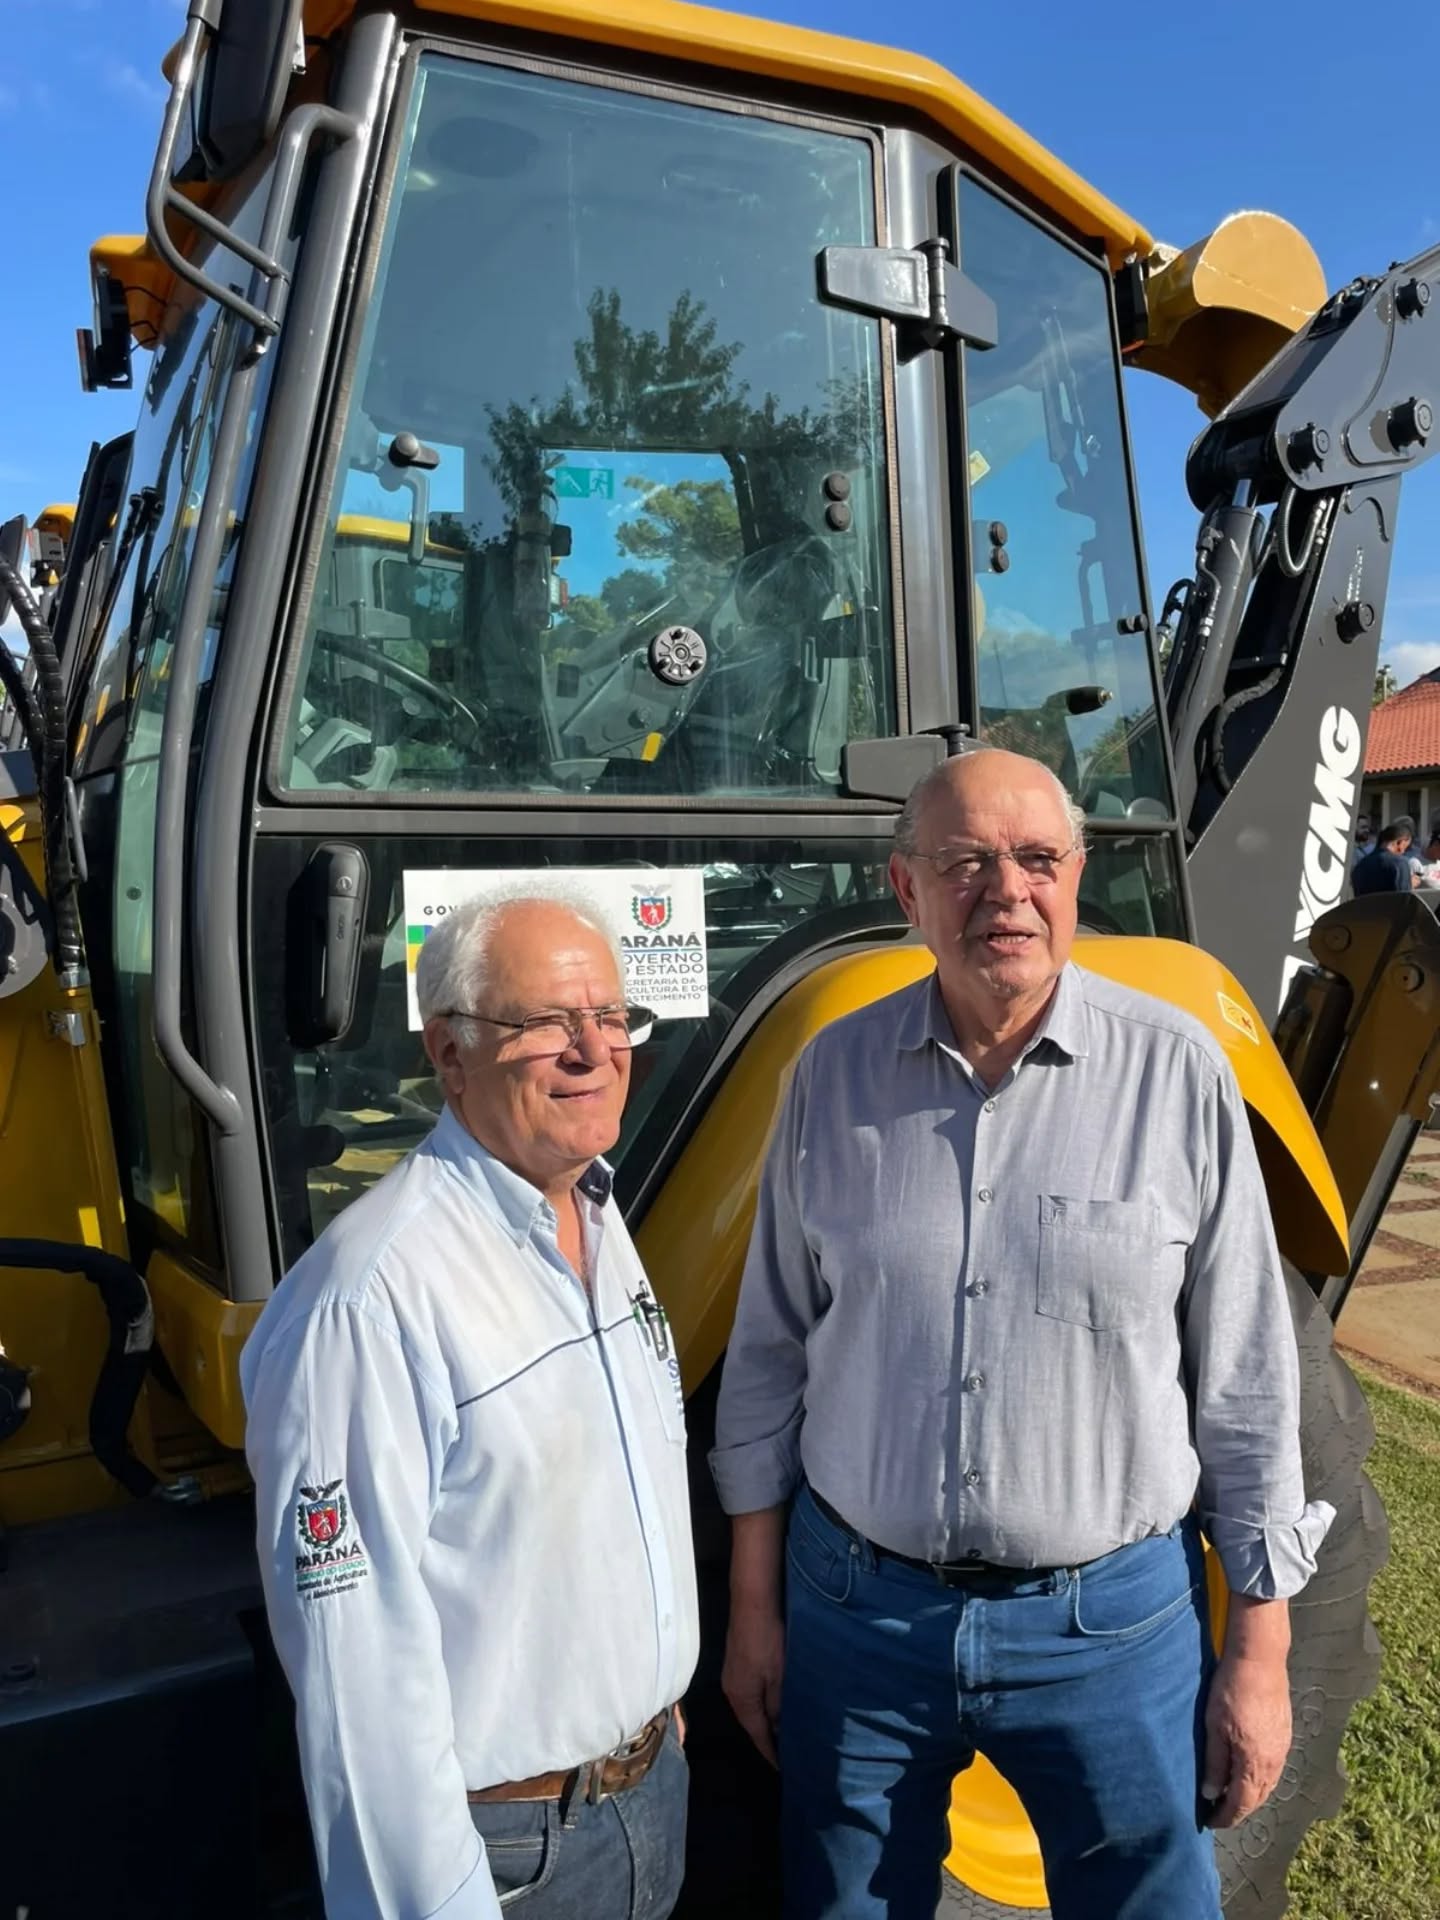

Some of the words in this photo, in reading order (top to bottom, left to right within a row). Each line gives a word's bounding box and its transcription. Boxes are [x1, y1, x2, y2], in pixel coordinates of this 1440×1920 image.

[423, 905, 457, 916] GOV
[621, 932, 702, 948] ARANÁ
[624, 952, 703, 965] OVERNO
[636, 963, 704, 975] ESTADO
[626, 978, 679, 986] CRETARIA
[682, 977, 697, 985] DA
[626, 986, 679, 995] ICULTURA
[691, 984, 707, 993] DO
[627, 992, 701, 1002] ASTECIMENTO
